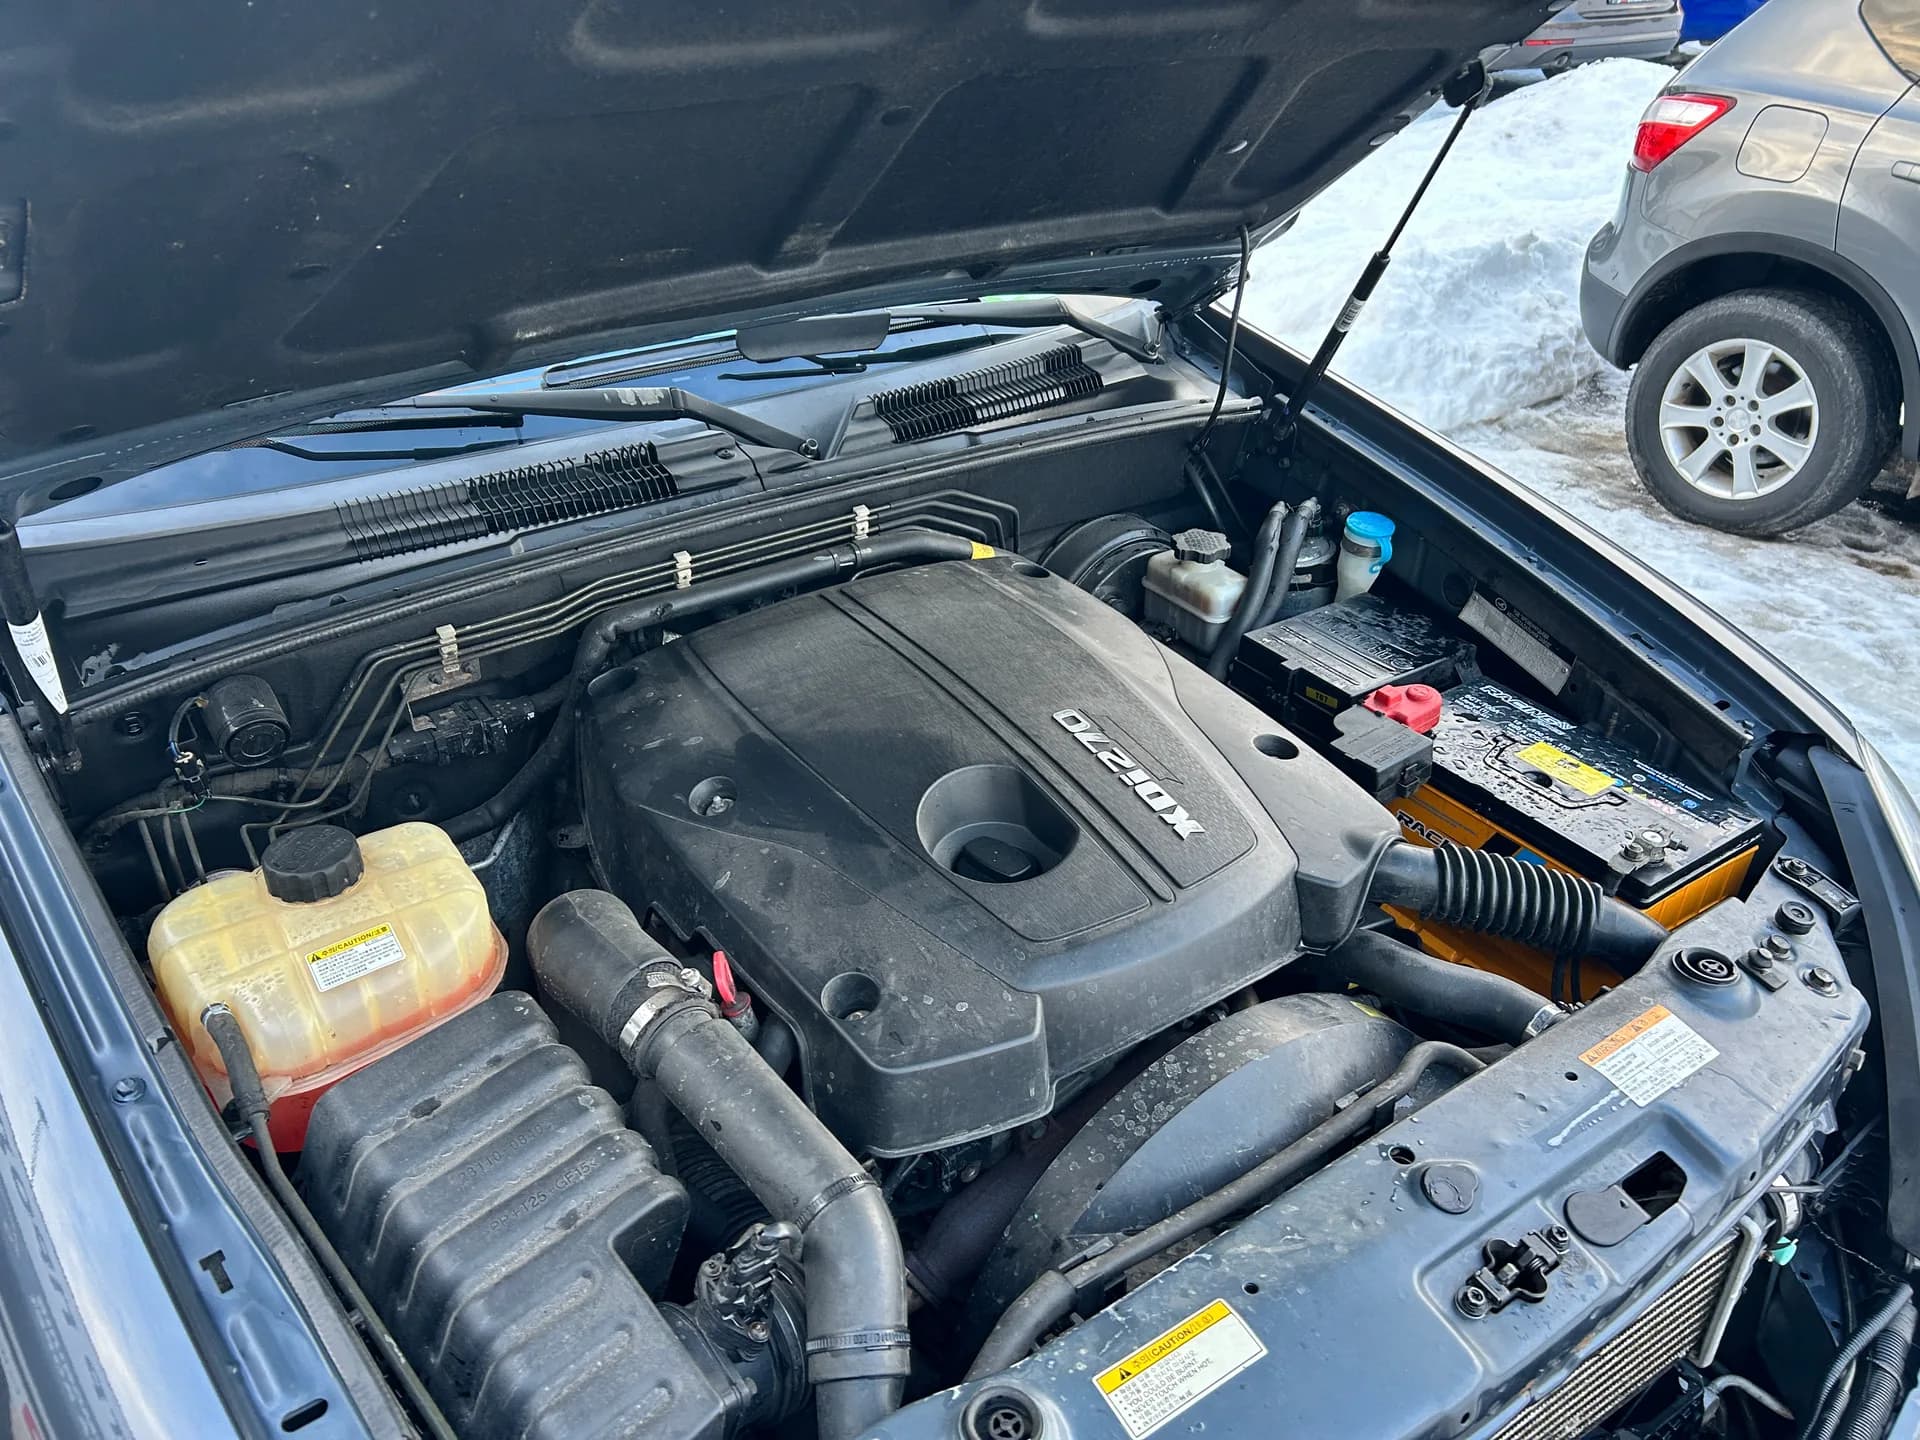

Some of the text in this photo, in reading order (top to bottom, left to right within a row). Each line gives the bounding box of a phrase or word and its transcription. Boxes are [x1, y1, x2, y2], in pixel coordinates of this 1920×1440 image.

[1052, 708, 1206, 841] XDi270
[1126, 1393, 1144, 1409] YOU
[1141, 1378, 1168, 1399] COULD
[1131, 1395, 1157, 1415] NEVER
[1153, 1379, 1179, 1400] TOUCH
[1175, 1366, 1199, 1385] WHEN
